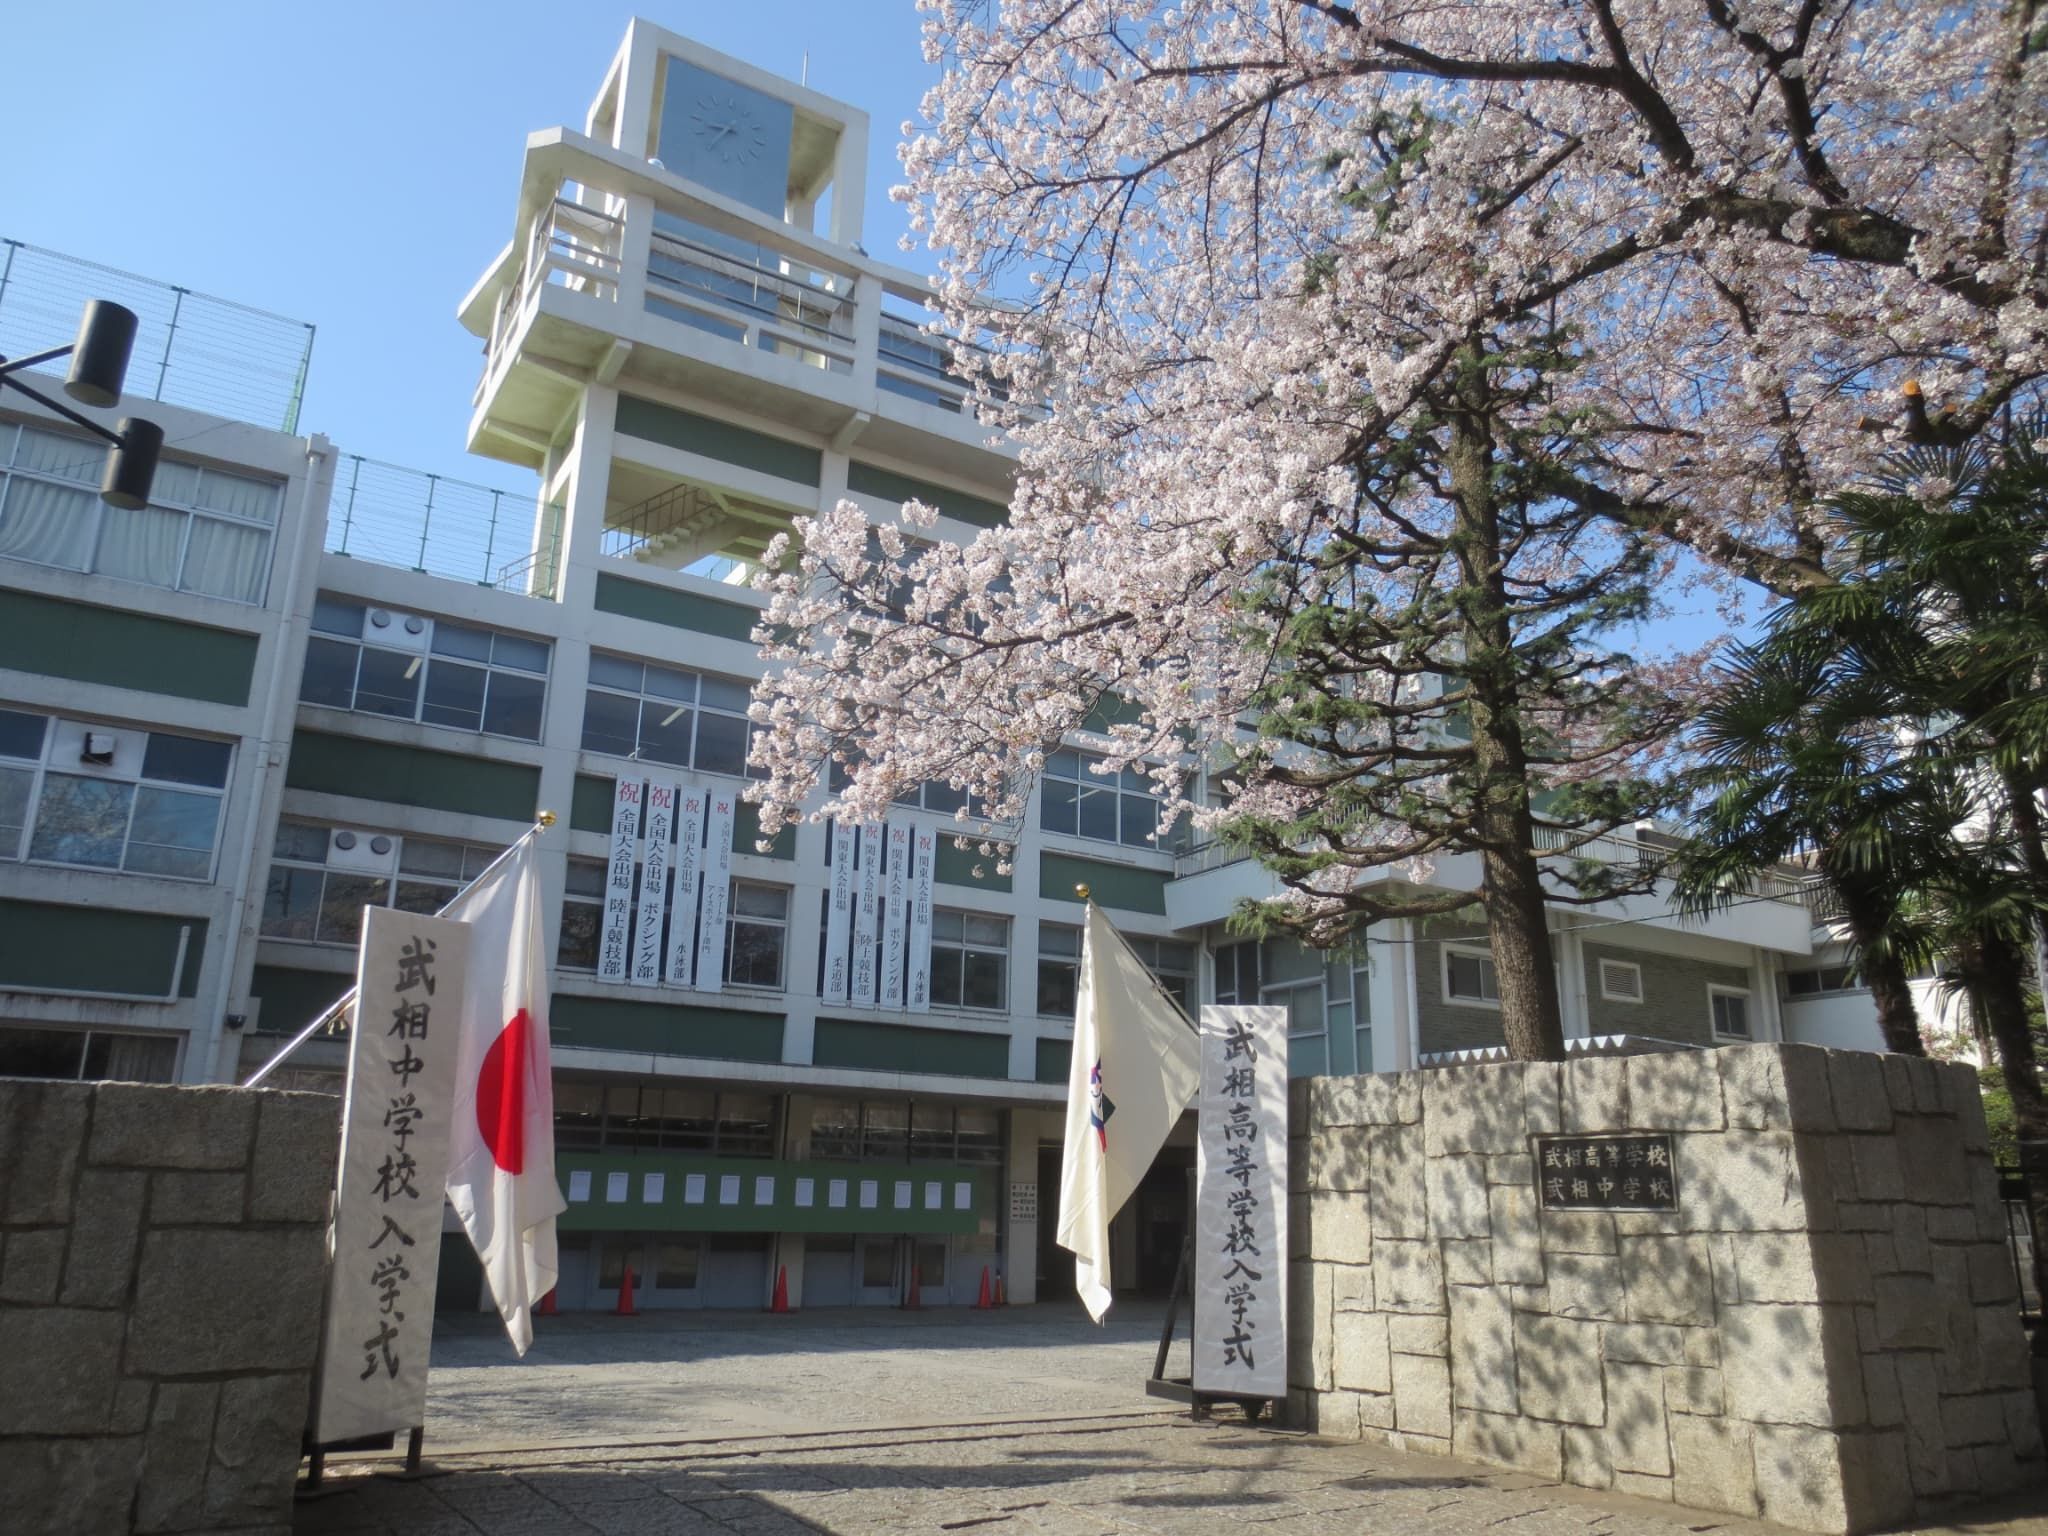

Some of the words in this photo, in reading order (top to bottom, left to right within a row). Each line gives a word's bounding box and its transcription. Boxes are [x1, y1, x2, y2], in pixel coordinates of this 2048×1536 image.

[619, 781, 640, 804] 祝
[651, 786, 671, 809] 祝
[685, 798, 699, 813] 祝
[717, 802, 728, 814] 祝
[612, 809, 636, 889] 全国大会出場
[645, 813, 666, 894] 全国大会出場
[681, 819, 696, 894] 全国大会出場
[893, 829, 904, 844] 祝
[919, 836, 931, 851] 祝
[836, 839, 849, 911] 関東大会出場
[863, 844, 876, 915] 関東大会出場
[890, 849, 903, 919] 関東大会出場
[917, 855, 929, 925] 関東大会出場
[604, 898, 627, 975] 陸上競技部
[637, 902, 659, 979] ボクシング部
[857, 934, 872, 995] 陸上競技部
[887, 928, 901, 1000] ボクシング部
[831, 957, 844, 993] 柔道部
[360, 936, 437, 1382] 武相中学校入学式
[1545, 1144, 1668, 1168] 武相高等学校
[1546, 1177, 1671, 1201] 武相中学校
[1222, 1022, 1262, 1371] 武相高等学校入学式
